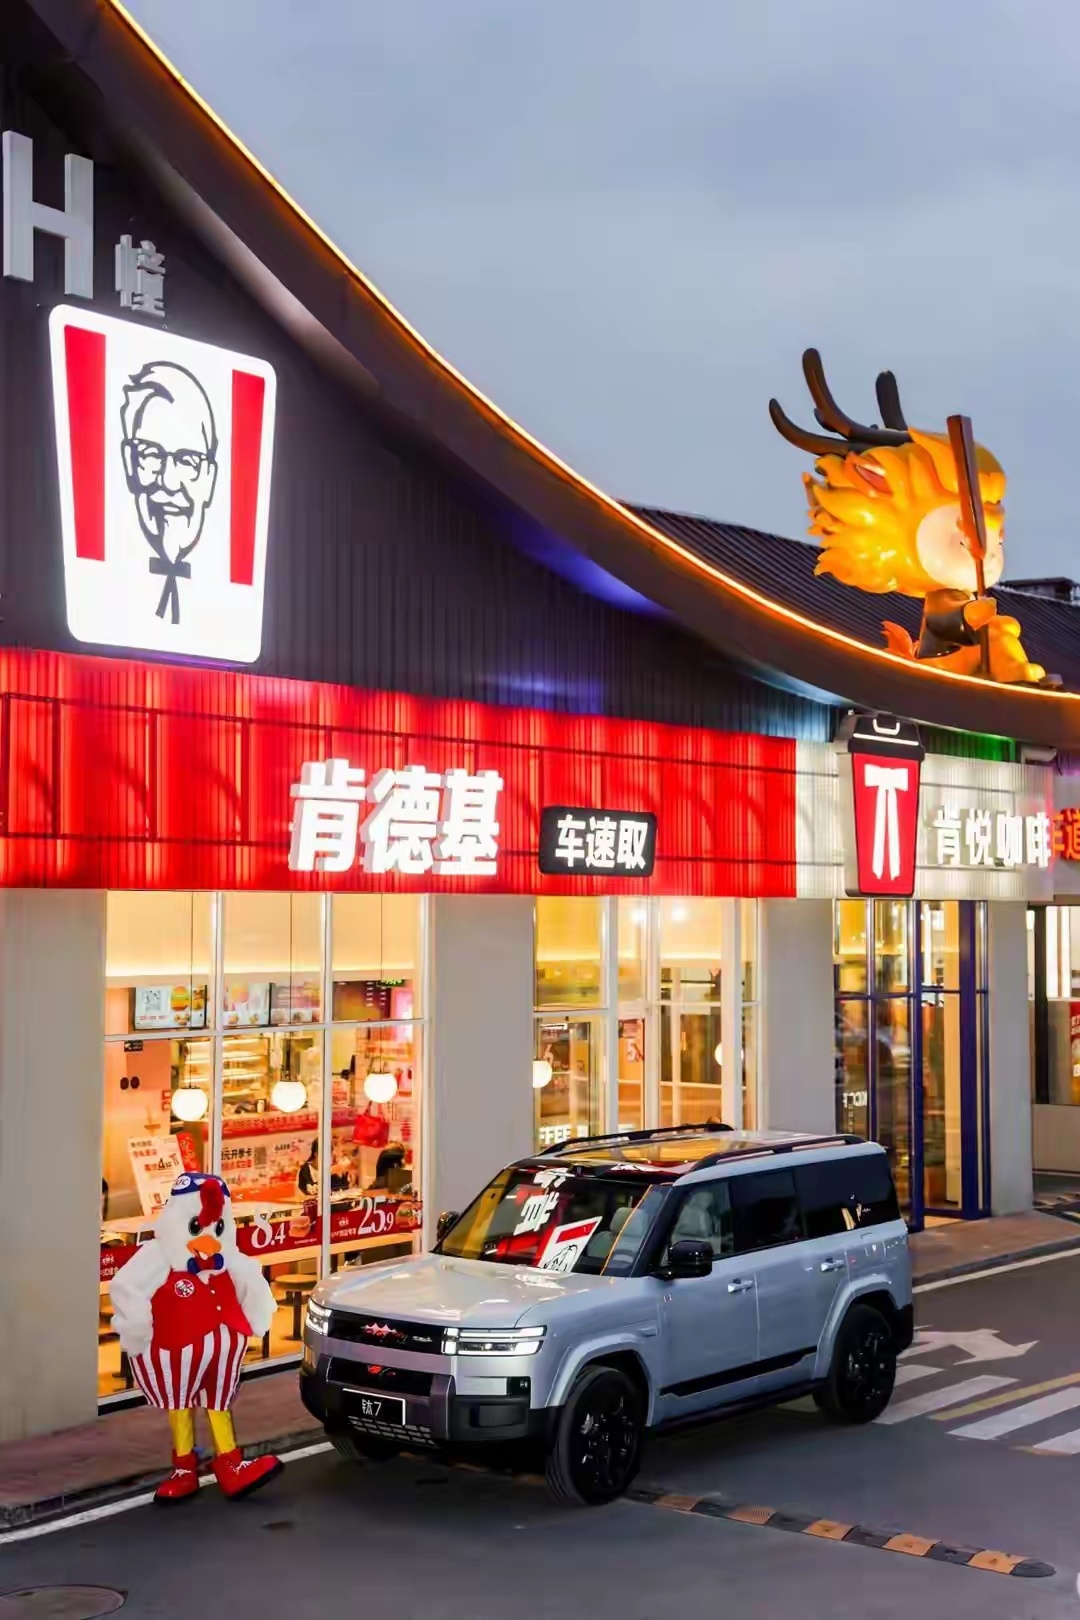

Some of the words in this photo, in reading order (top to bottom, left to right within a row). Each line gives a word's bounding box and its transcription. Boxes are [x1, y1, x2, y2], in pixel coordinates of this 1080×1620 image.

[2, 130, 94, 300] H
[287, 758, 504, 876] 肯德基
[555, 814, 649, 871] 车速取
[931, 803, 1051, 869] 肯悦咖啡
[250, 1204, 287, 1249] 8.4
[357, 1195, 395, 1236] 25.9
[361, 1398, 383, 1417] 钛7
